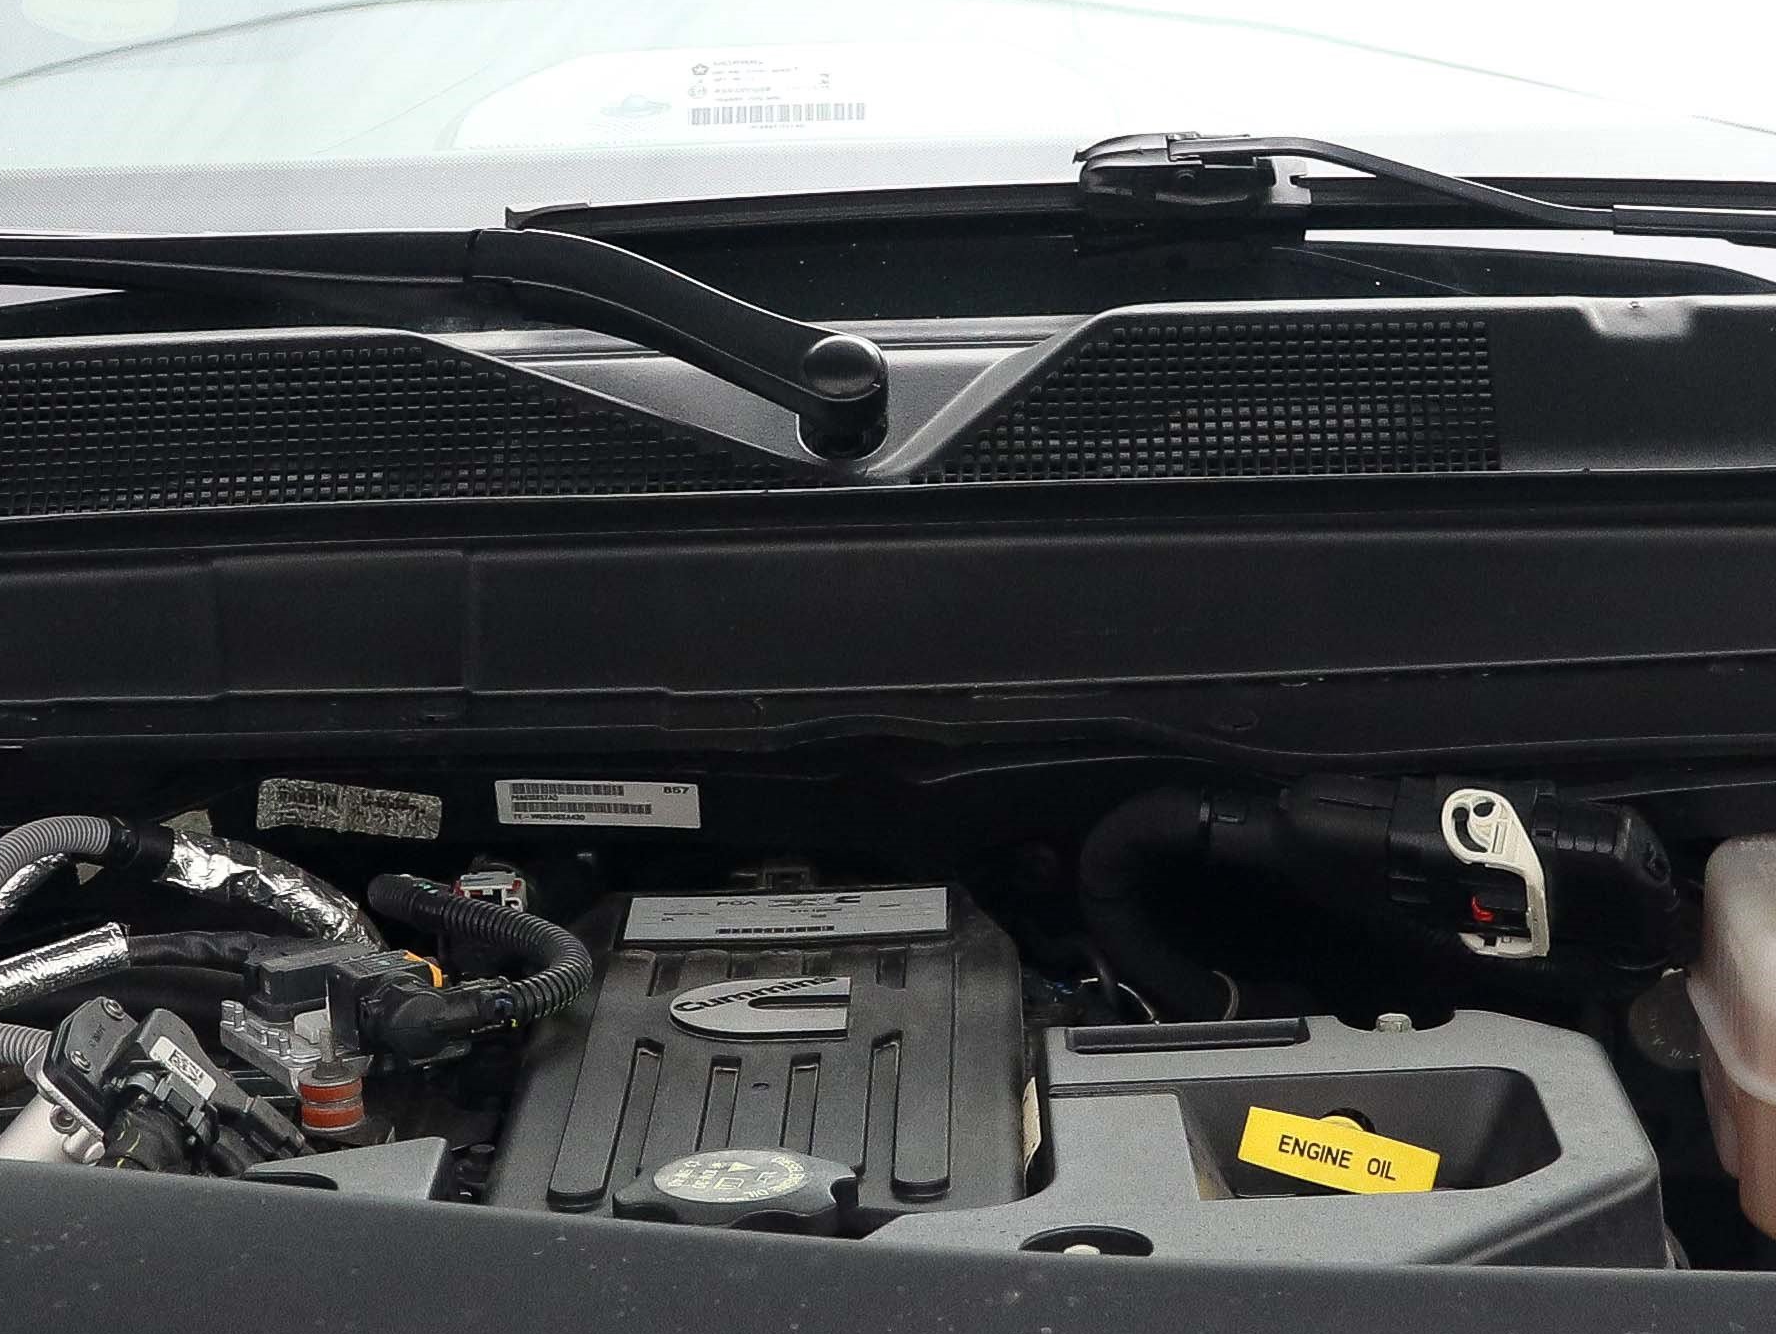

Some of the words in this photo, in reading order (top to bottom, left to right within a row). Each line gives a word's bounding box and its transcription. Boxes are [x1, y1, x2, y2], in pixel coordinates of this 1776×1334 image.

[672, 976, 839, 1012] Cummins
[1277, 1133, 1354, 1170] ENGINE
[1366, 1157, 1397, 1181] OIL
